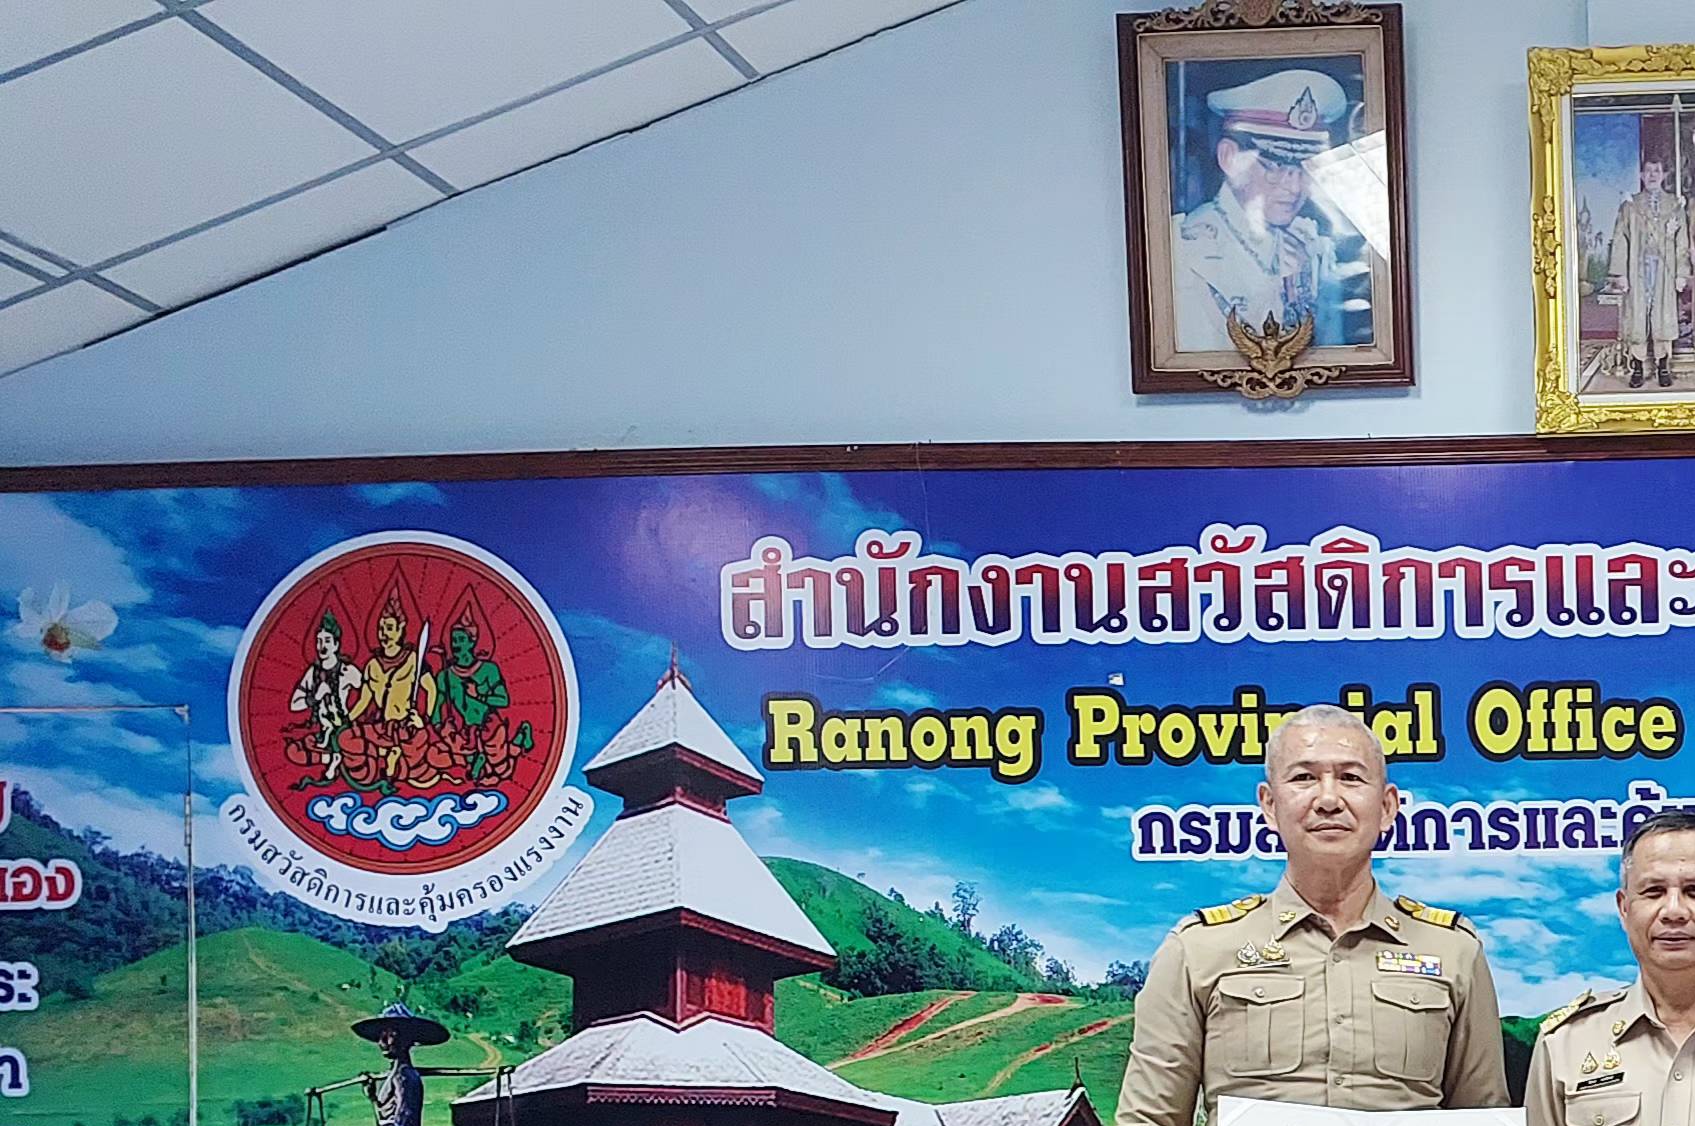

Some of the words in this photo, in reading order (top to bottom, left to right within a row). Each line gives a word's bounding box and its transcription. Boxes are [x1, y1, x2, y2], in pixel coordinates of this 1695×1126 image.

[767, 701, 1037, 776] Ranong
[1073, 690, 1438, 758] Provial
[1475, 687, 1677, 754] Office
[227, 795, 585, 923] กรมสวัสดิการและคุ้มครองแรงงาน
